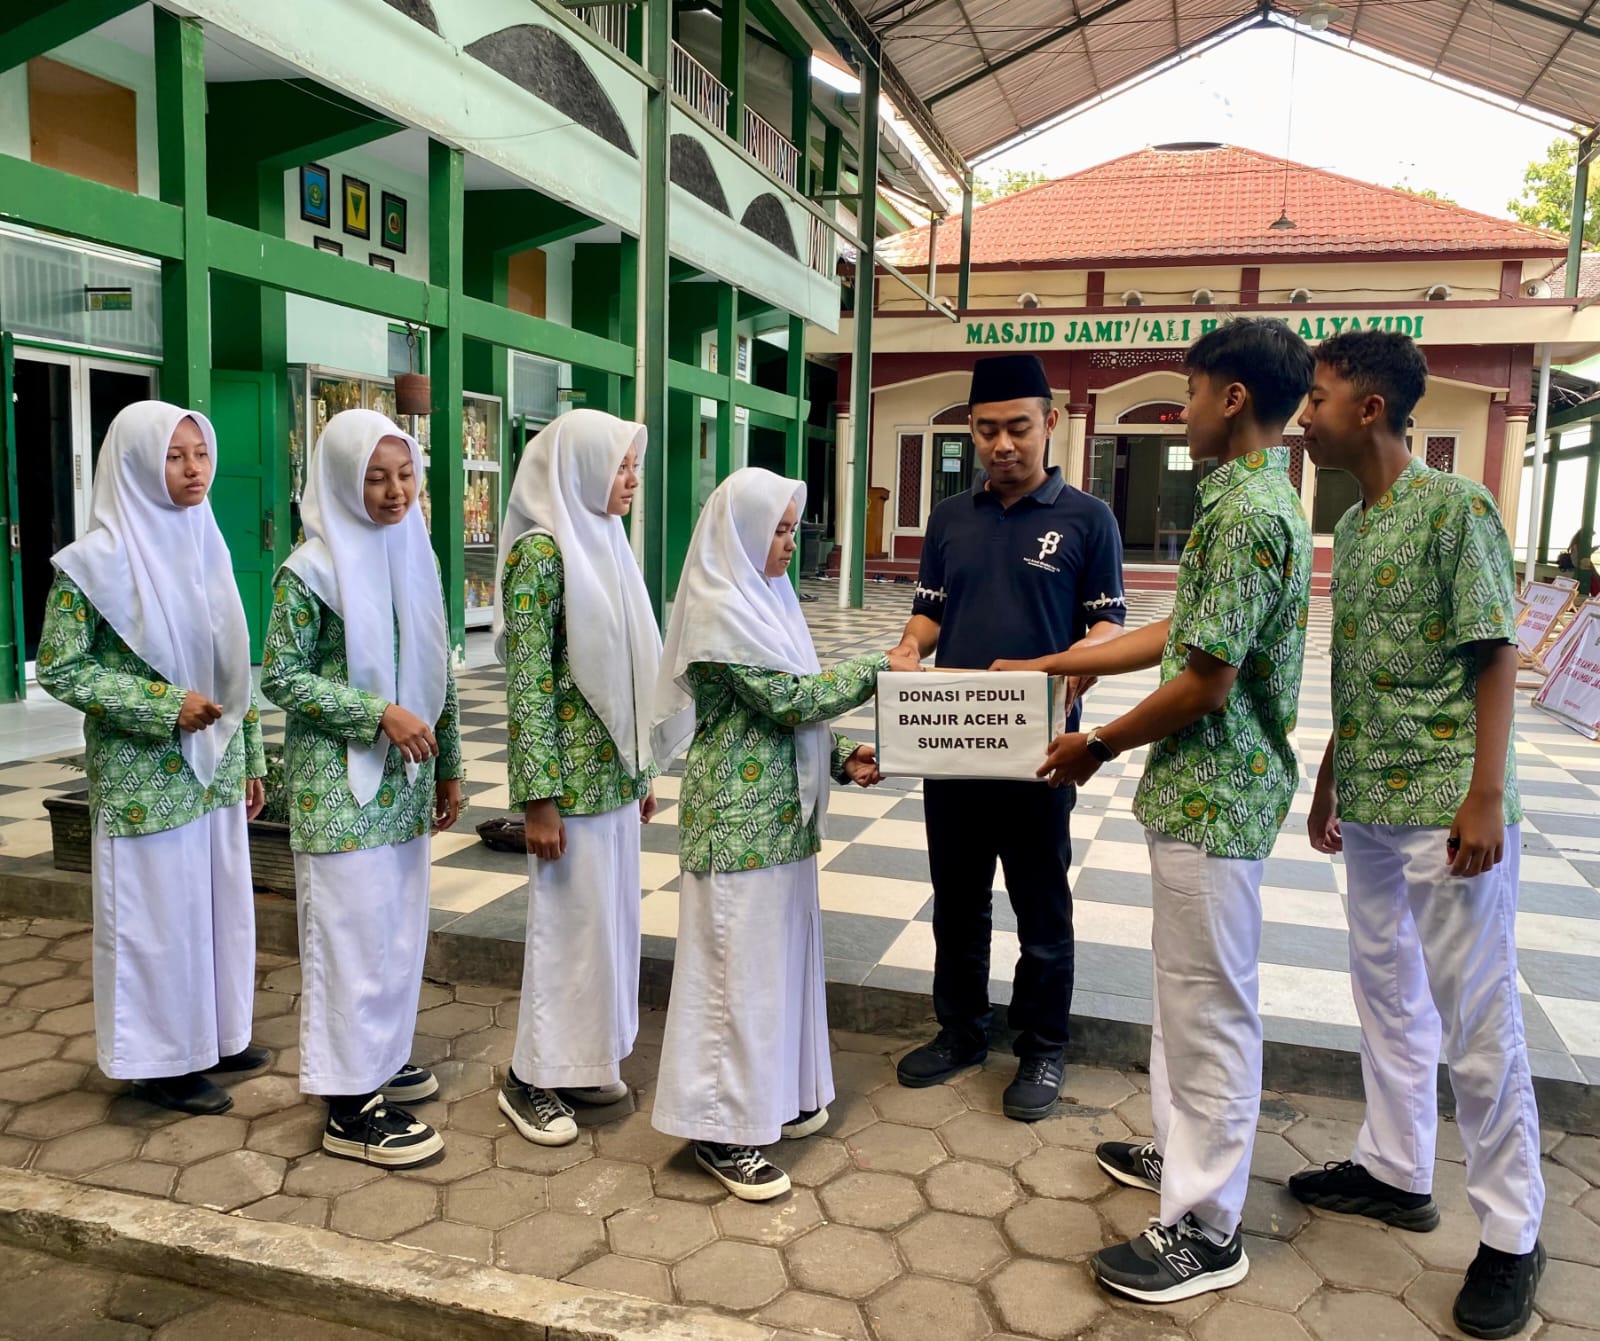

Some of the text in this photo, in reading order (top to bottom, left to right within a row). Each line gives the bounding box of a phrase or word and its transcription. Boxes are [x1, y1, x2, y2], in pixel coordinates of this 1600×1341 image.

[966, 322, 1055, 345] MASJID
[899, 689, 1025, 703] DONASI PEDULI
[898, 713, 1027, 726] BANJIR ACEH &
[917, 737, 1009, 749] SUMATERA
[1165, 1248, 1202, 1278] N
